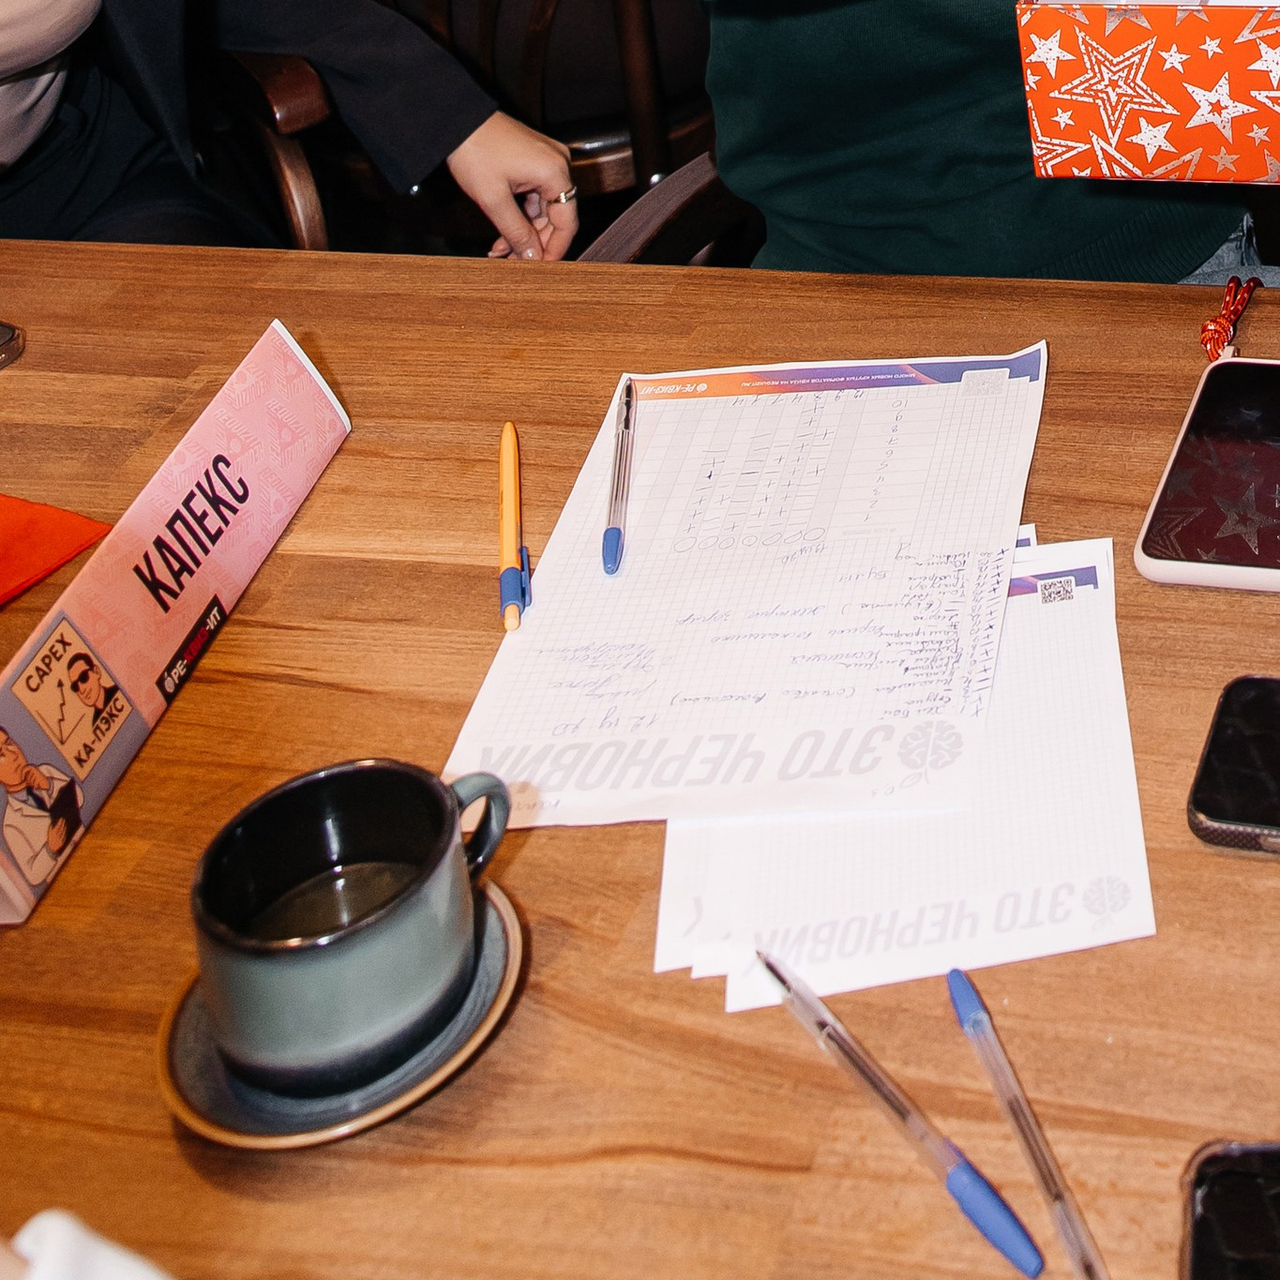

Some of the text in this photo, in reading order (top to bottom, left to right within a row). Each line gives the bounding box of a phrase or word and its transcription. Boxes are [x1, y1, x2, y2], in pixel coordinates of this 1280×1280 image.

[131, 453, 251, 613] КАПЕКС
[24, 631, 73, 694] CAPEX
[74, 695, 126, 770] КА-ПЭКС
[778, 725, 895, 782] ЭТО
[993, 881, 1075, 934] ЭТО
